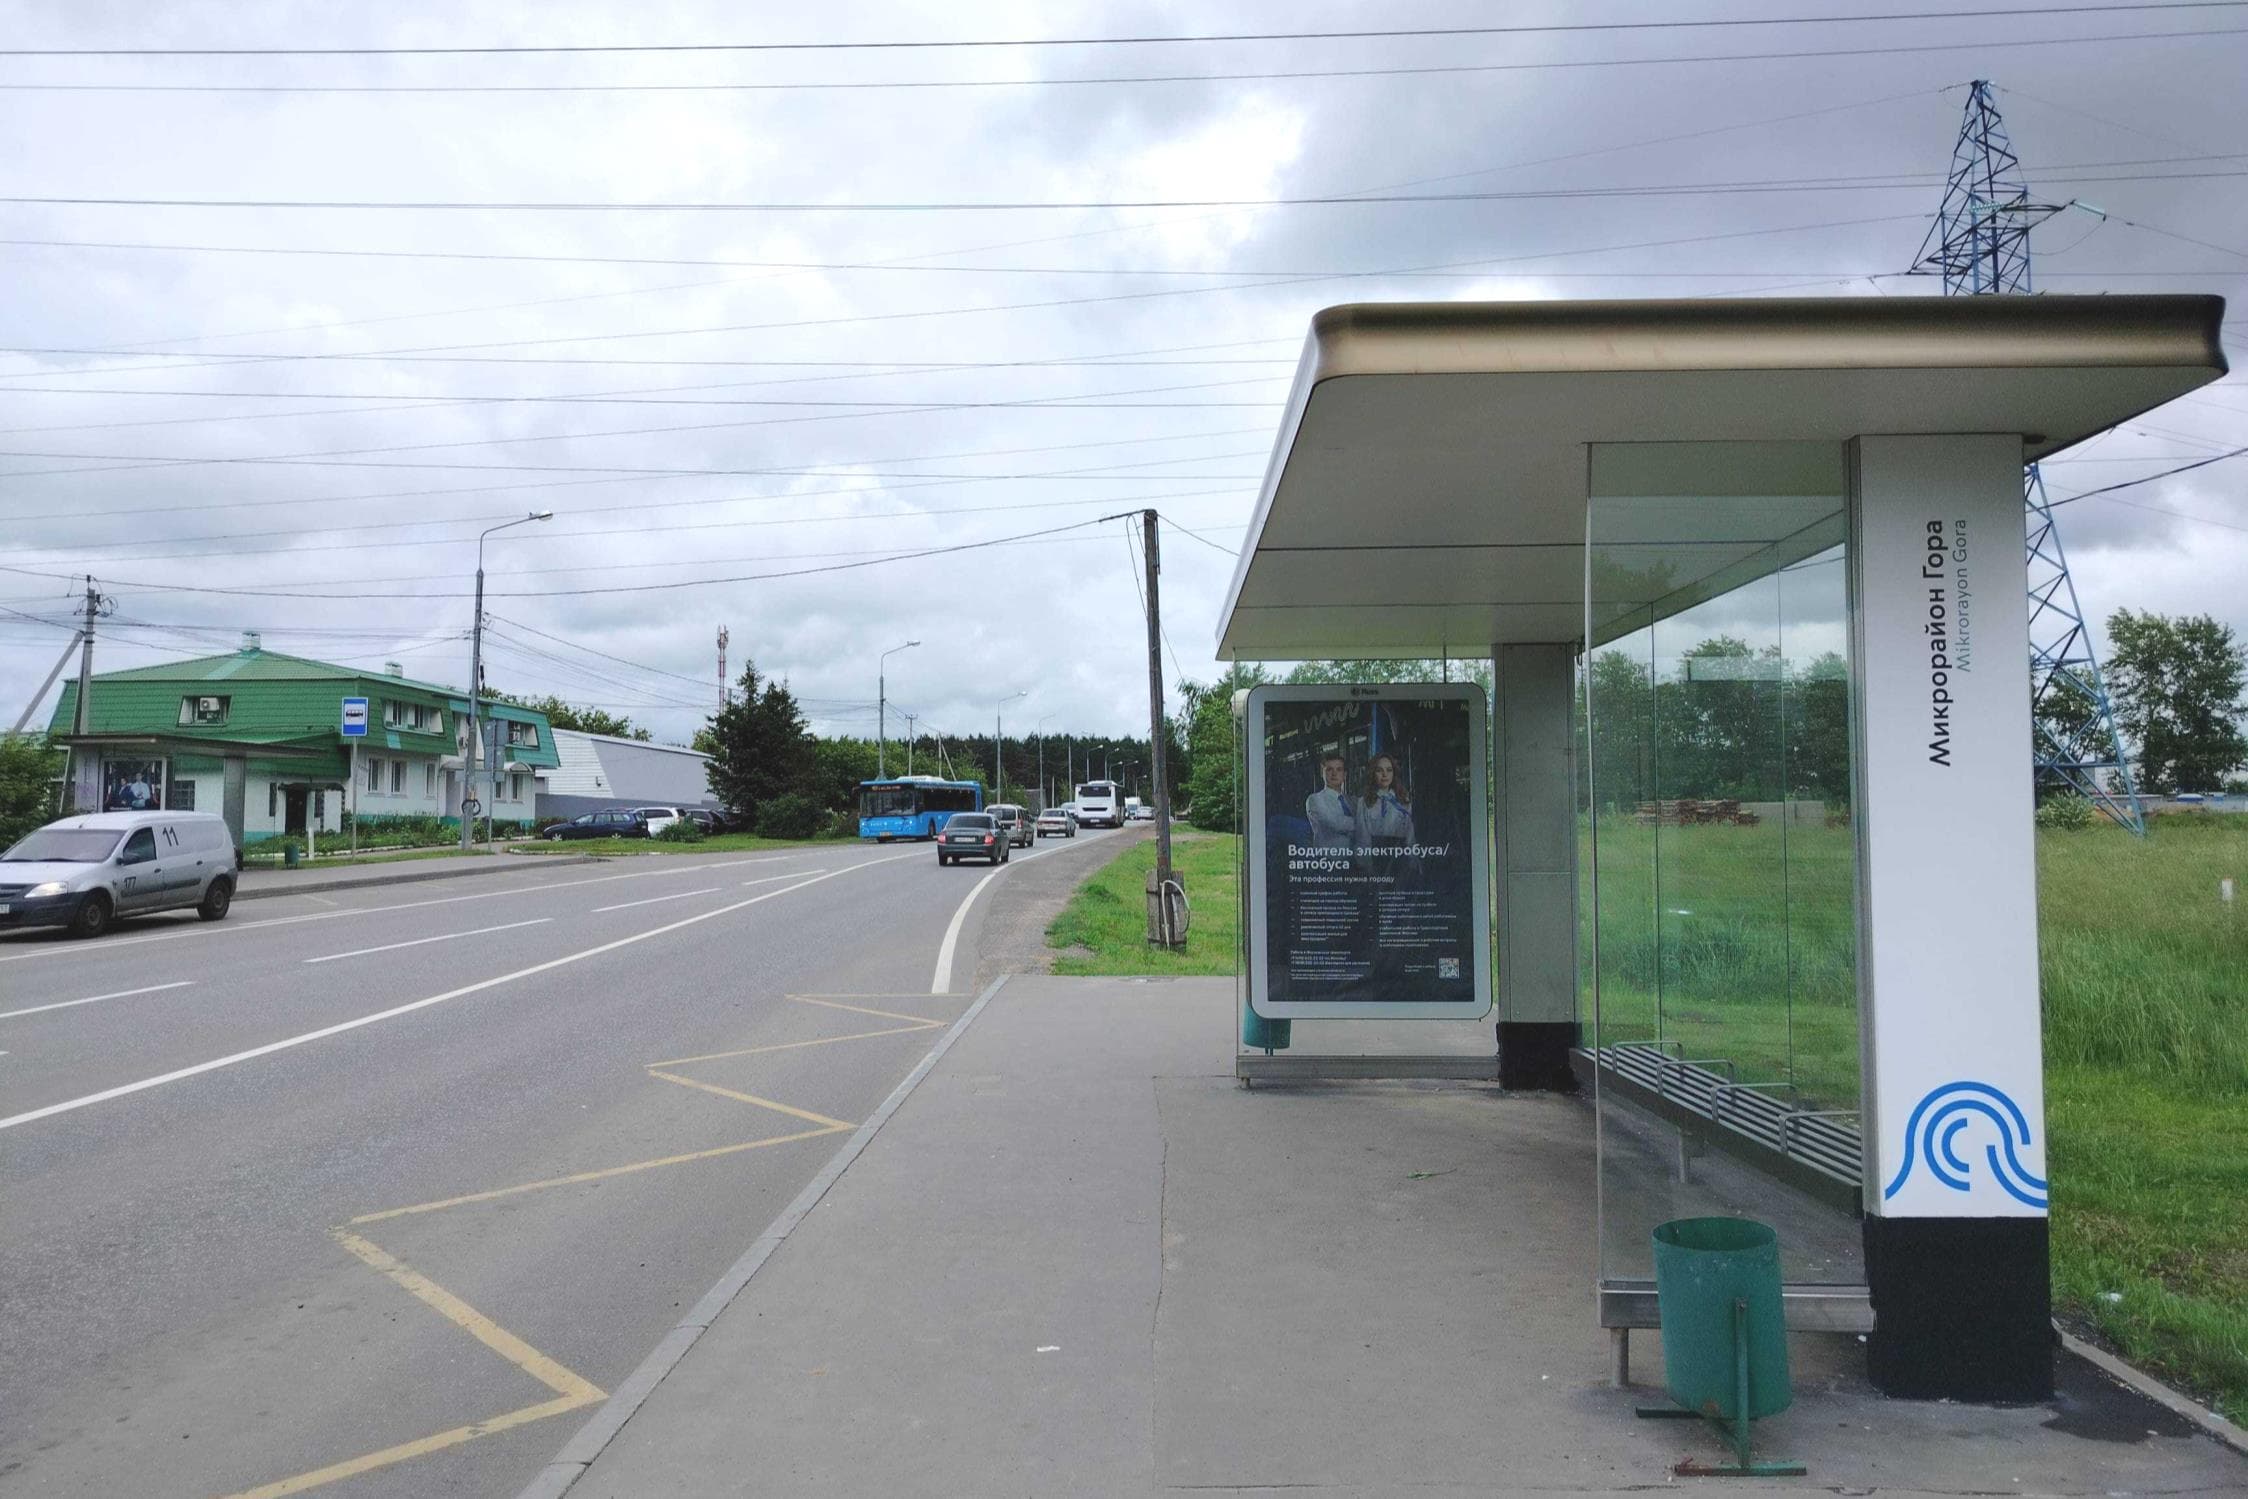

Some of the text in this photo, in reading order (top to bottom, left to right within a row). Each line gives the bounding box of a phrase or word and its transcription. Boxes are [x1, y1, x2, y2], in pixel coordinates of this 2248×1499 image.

[1952, 519, 1972, 672] Mikrorayon Gora
[1923, 520, 1954, 767] Микрорайон Гора
[162, 826, 179, 847] 11
[1288, 843, 1450, 858] Водитель электробуса/
[1288, 858, 1350, 872] автобуса
[124, 876, 137, 889] 177
[1289, 874, 1395, 884] Эта профессия нужна городу
